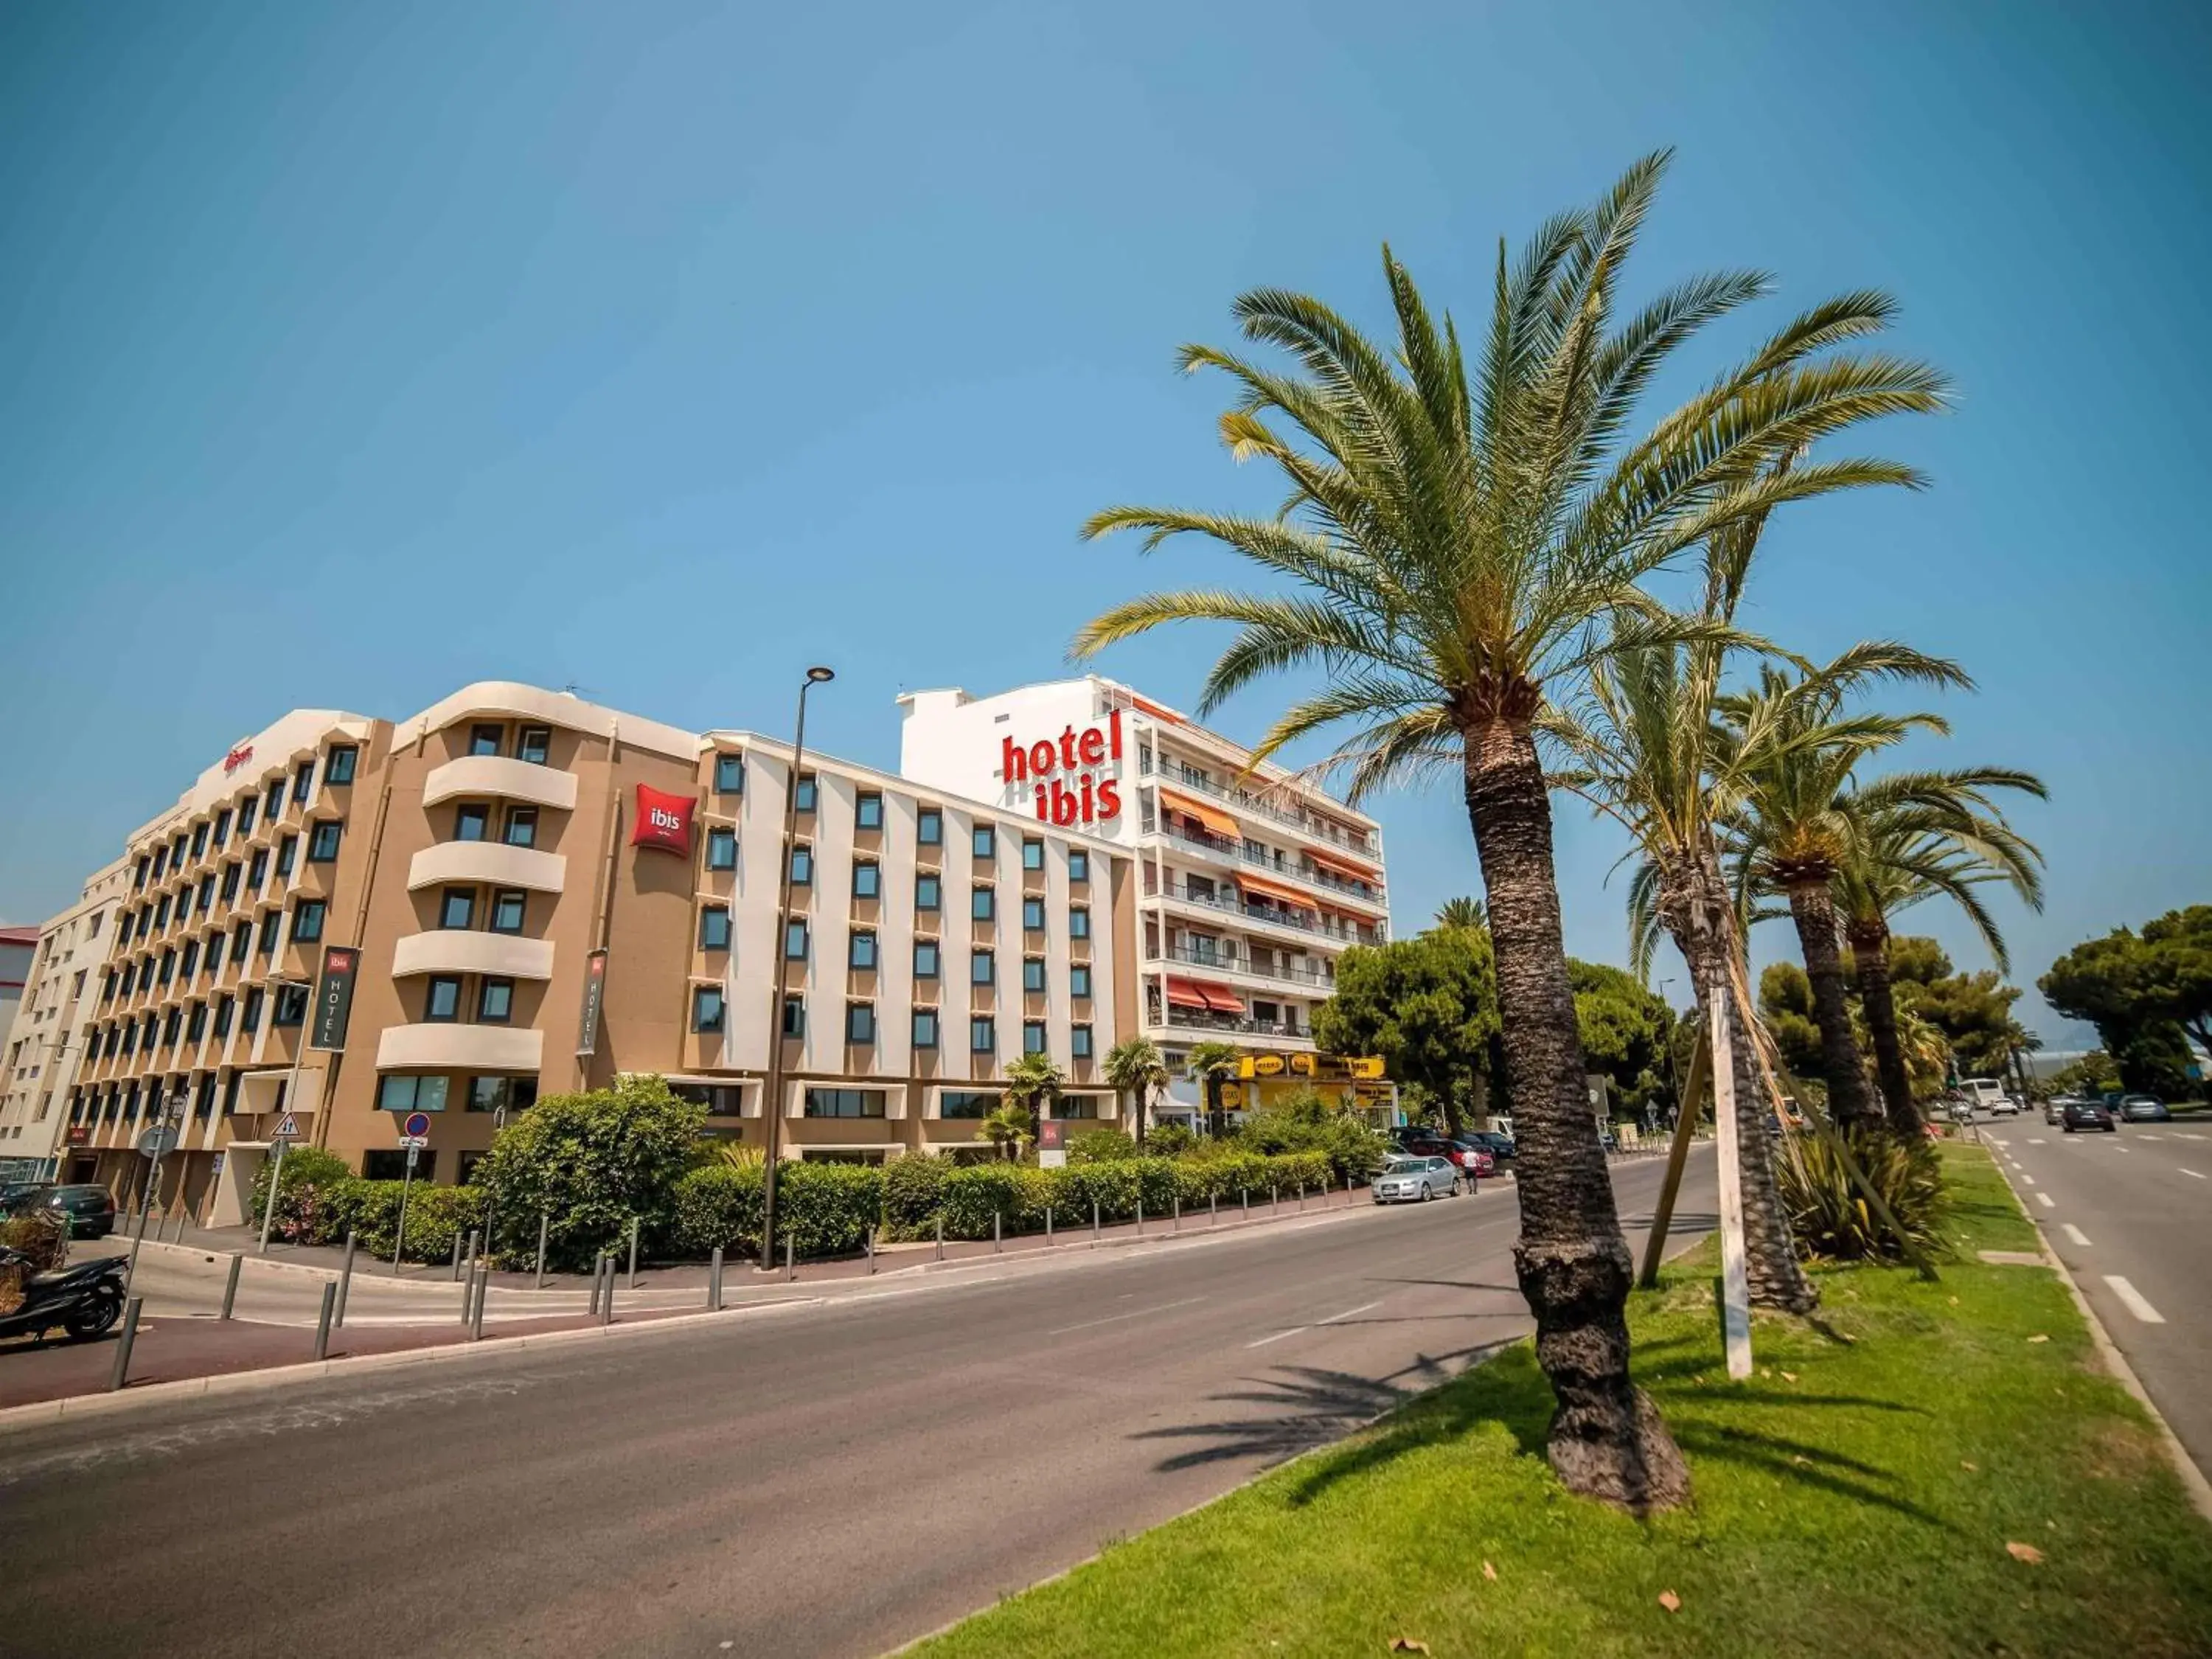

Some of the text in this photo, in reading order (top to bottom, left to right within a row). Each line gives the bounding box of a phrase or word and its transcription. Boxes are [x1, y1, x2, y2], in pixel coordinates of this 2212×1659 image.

[1003, 708, 1121, 785] hotel
[651, 807, 679, 830] ibis
[1034, 773, 1121, 827] ibis
[331, 956, 348, 967] ibis
[324, 980, 341, 1042] HOTEL
[585, 983, 597, 1045] HOTEL
